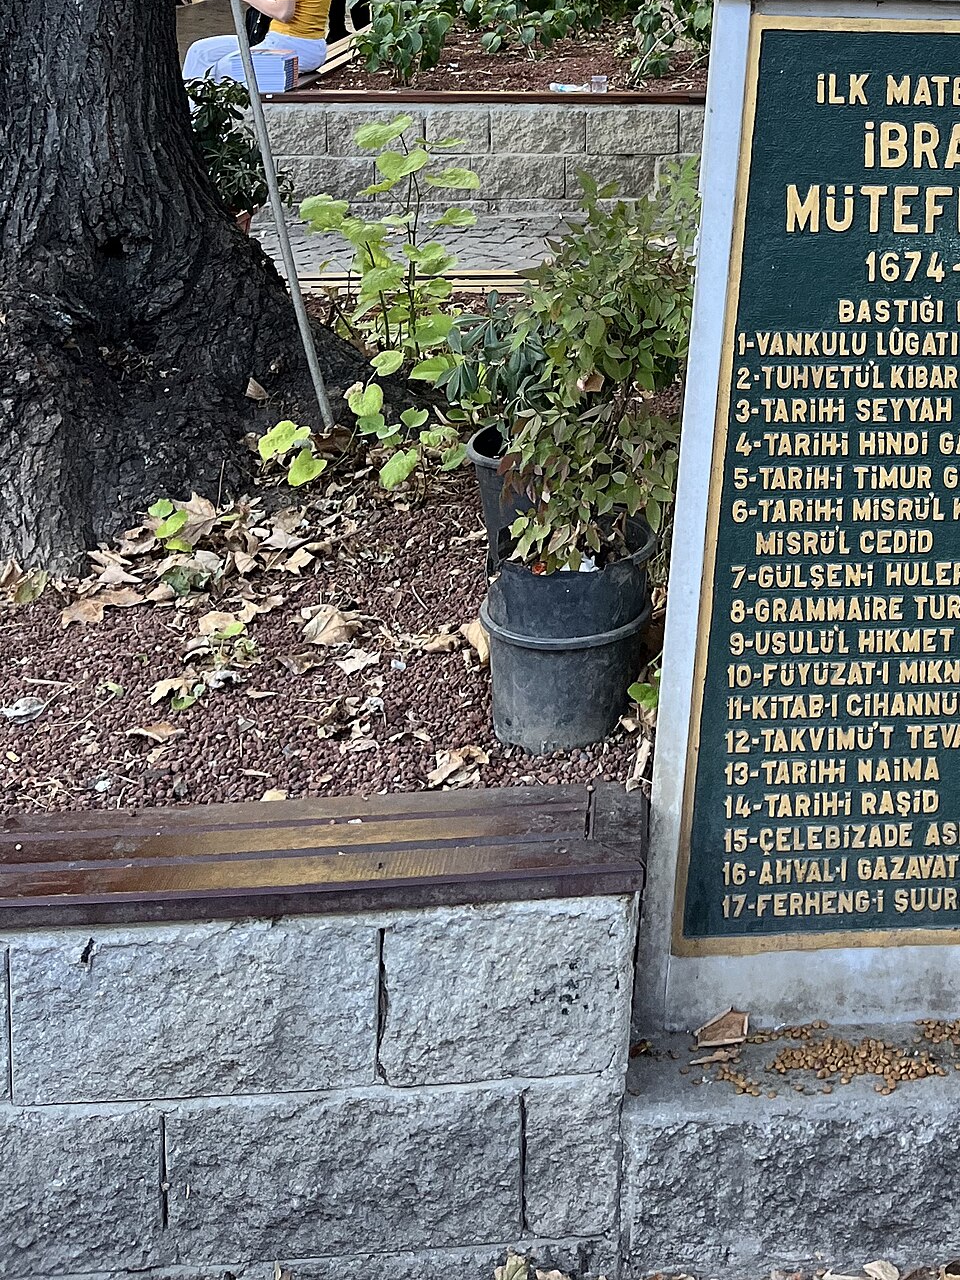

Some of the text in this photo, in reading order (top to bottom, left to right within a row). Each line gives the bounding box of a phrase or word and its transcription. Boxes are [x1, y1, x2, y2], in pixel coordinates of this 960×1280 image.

[816, 73, 870, 105] İLK
[838, 294, 944, 323] BASTIĞI
[737, 331, 867, 356] 1-VANKULU
[890, 364, 958, 389] KİBAR
[855, 396, 952, 422] SEYYAH
[735, 431, 849, 457] 4-TARİH-İ
[859, 431, 928, 456] HİNDİ
[733, 466, 843, 490] 5-TARİH-İ
[853, 465, 932, 490] TİMUR
[732, 497, 844, 523] 6-TARİH-İ
[859, 528, 933, 554] CEDİD
[731, 562, 874, 591] 7-GÜLŞEN-İ
[858, 627, 955, 653] HİKMET
[857, 756, 940, 783] NAİMA
[724, 789, 939, 819] 14-TARİH-İ RAŞİD
[723, 821, 913, 856] 15-ÇELEBİZADE
[857, 853, 960, 881] GAZAVAT
